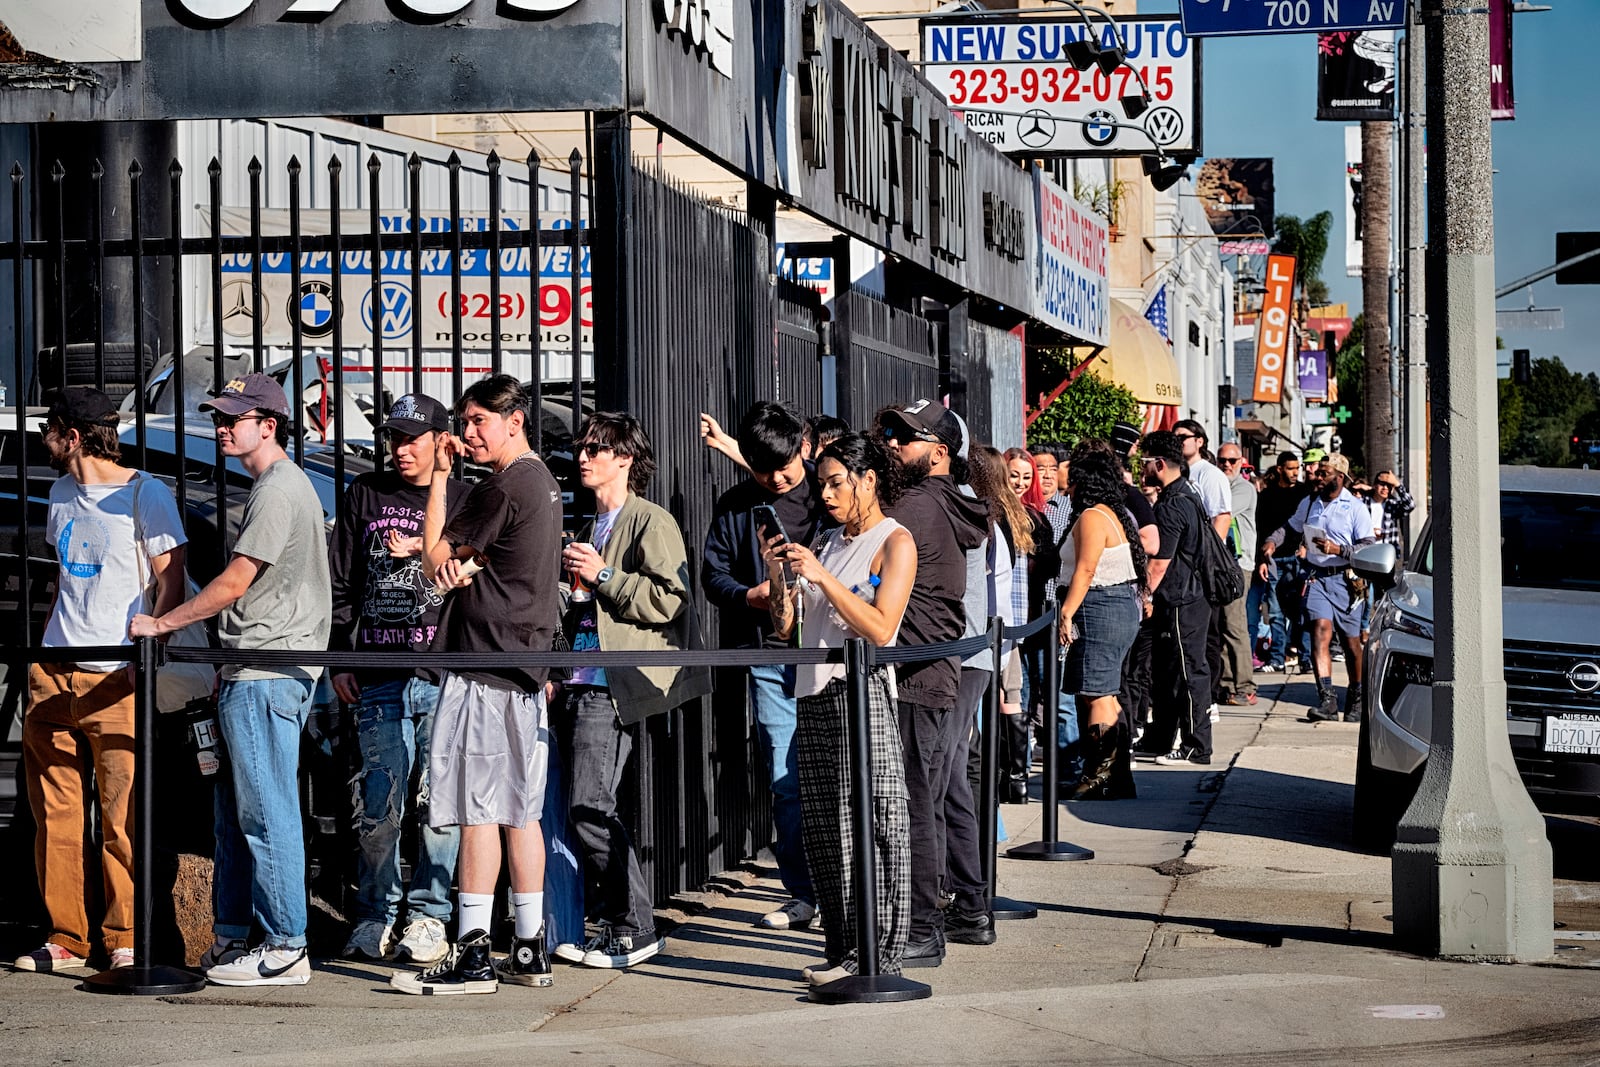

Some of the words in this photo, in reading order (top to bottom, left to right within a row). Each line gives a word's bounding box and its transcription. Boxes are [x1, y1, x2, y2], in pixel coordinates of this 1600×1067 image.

[1264, 1, 1311, 27] 700
[1323, 0, 1339, 24] N
[931, 27, 1005, 62] NEW
[1017, 25, 1085, 61] SUN
[1101, 22, 1189, 58] AUTO
[949, 66, 1173, 105] 323-932-0715
[966, 113, 1004, 126] RICAN
[977, 131, 1006, 144] IGN
[1259, 263, 1290, 394] LIQUOR
[1156, 383, 1171, 397] 691
[71, 564, 95, 575] NOTE
[1544, 745, 1589, 754] MISSION
